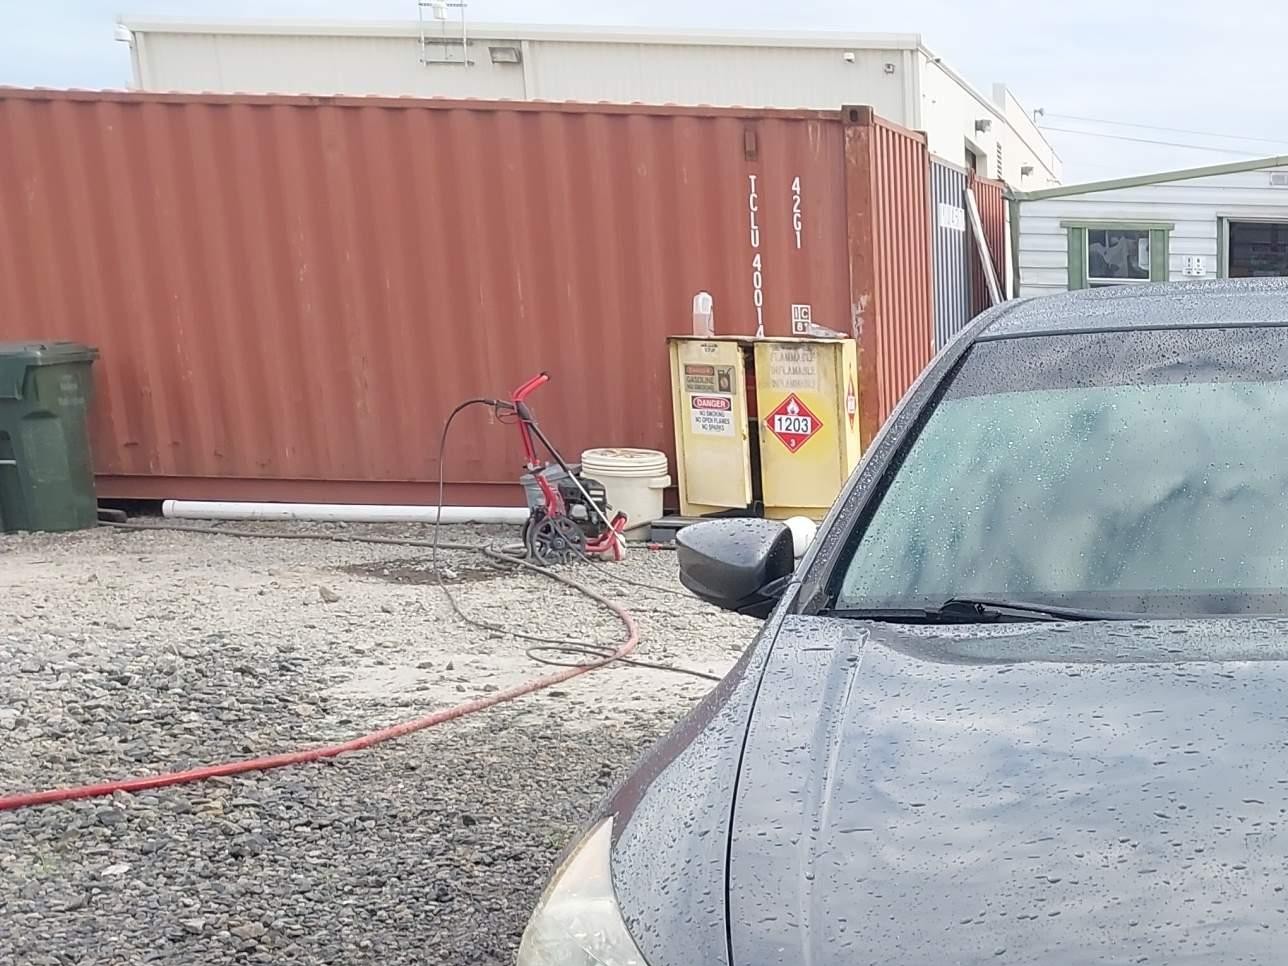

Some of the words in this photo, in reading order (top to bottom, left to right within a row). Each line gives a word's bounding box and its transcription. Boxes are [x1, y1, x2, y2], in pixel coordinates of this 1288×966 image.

[749, 175, 760, 248] TCLU
[791, 176, 802, 249] 42G1
[697, 400, 726, 408] DANGER
[777, 417, 809, 433] 1203
[790, 438, 796, 447] 3
